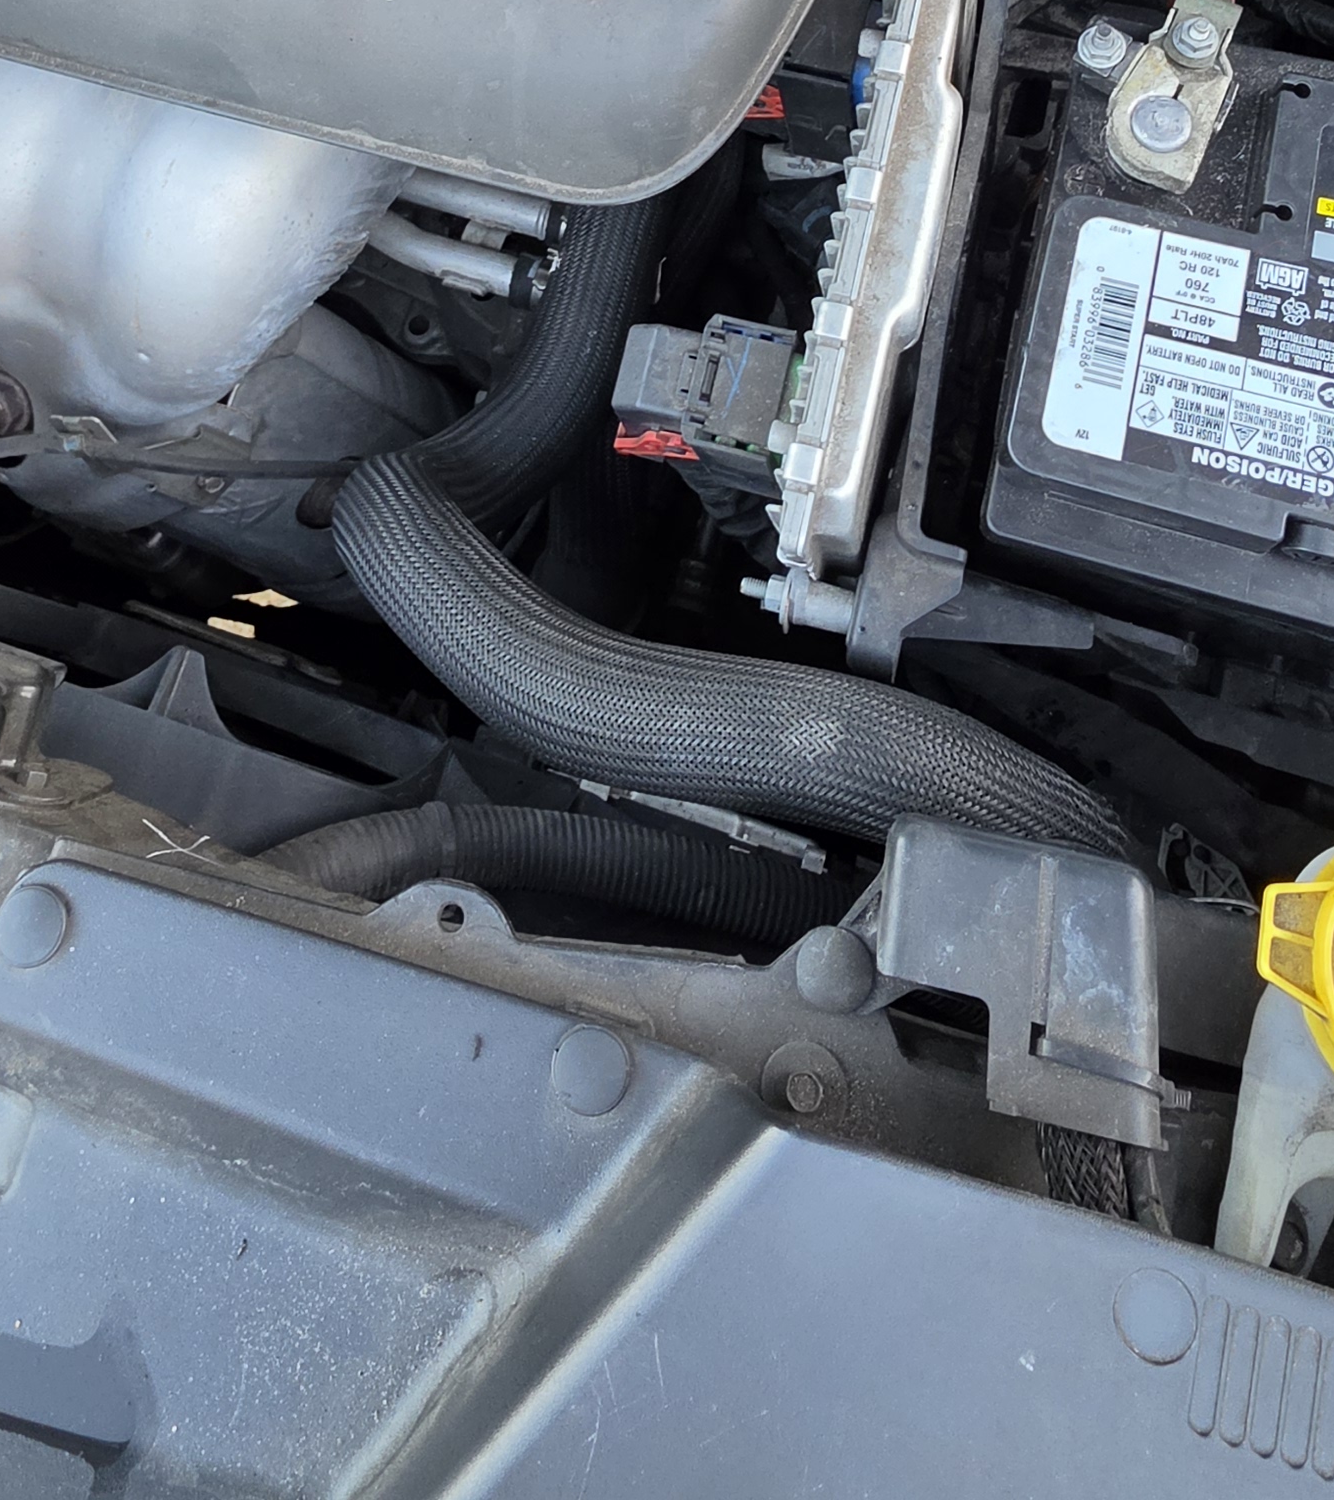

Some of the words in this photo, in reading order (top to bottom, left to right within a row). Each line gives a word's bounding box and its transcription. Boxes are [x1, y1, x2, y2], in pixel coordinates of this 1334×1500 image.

[1164, 243, 1187, 256] Rate
[1188, 248, 1212, 262] 20Hr
[1177, 259, 1197, 273] RC
[1214, 254, 1239, 268] 70Ah
[1199, 264, 1220, 278] 120
[1262, 265, 1303, 285] AGM
[1183, 276, 1210, 293] 760
[1086, 285, 1104, 325] 83996
[1198, 294, 1215, 304] CCA
[1072, 298, 1083, 323] SUPER
[1170, 307, 1215, 329] 48PLT
[1067, 323, 1079, 348] START
[1169, 326, 1186, 339] NO.
[1186, 330, 1210, 345] PART
[1255, 322, 1317, 348] INSTRUCTIONS.
[1077, 327, 1096, 369] 03286
[1260, 335, 1278, 349] FOR
[1144, 343, 1183, 362] BATTERY.
[1184, 353, 1207, 368] OPEN
[1258, 345, 1276, 360] NOT
[1276, 350, 1290, 363] DO
[1208, 359, 1226, 372] NOT
[1227, 363, 1240, 376] DO
[1322, 361, 1334, 374] OR
[1141, 369, 1165, 386] FAST.
[1165, 376, 1189, 392] HELP
[1246, 363, 1316, 390] INSTRUCTIONS.
[1073, 381, 1083, 390] 6
[1138, 381, 1156, 396] GET
[1190, 381, 1229, 402] MEDICAL
[1271, 381, 1288, 395] ALL
[1289, 385, 1314, 401] READ
[1170, 395, 1202, 413] WATER.
[1203, 403, 1225, 419] WITH
[1230, 397, 1261, 414] BURNS.
[1167, 407, 1224, 431] IMMEDIATELY
[1232, 409, 1277, 430] BLINDNESS
[1262, 405, 1292, 422] SEVERE
[1293, 413, 1305, 426] OR
[1074, 427, 1090, 440] 12V
[1172, 421, 1194, 437] EYES
[1195, 426, 1222, 444] FLUSH
[1261, 428, 1278, 441] CAN
[1278, 420, 1304, 436] CAUSE
[1279, 433, 1302, 449] ACID
[1255, 441, 1301, 463] SULFURIC
